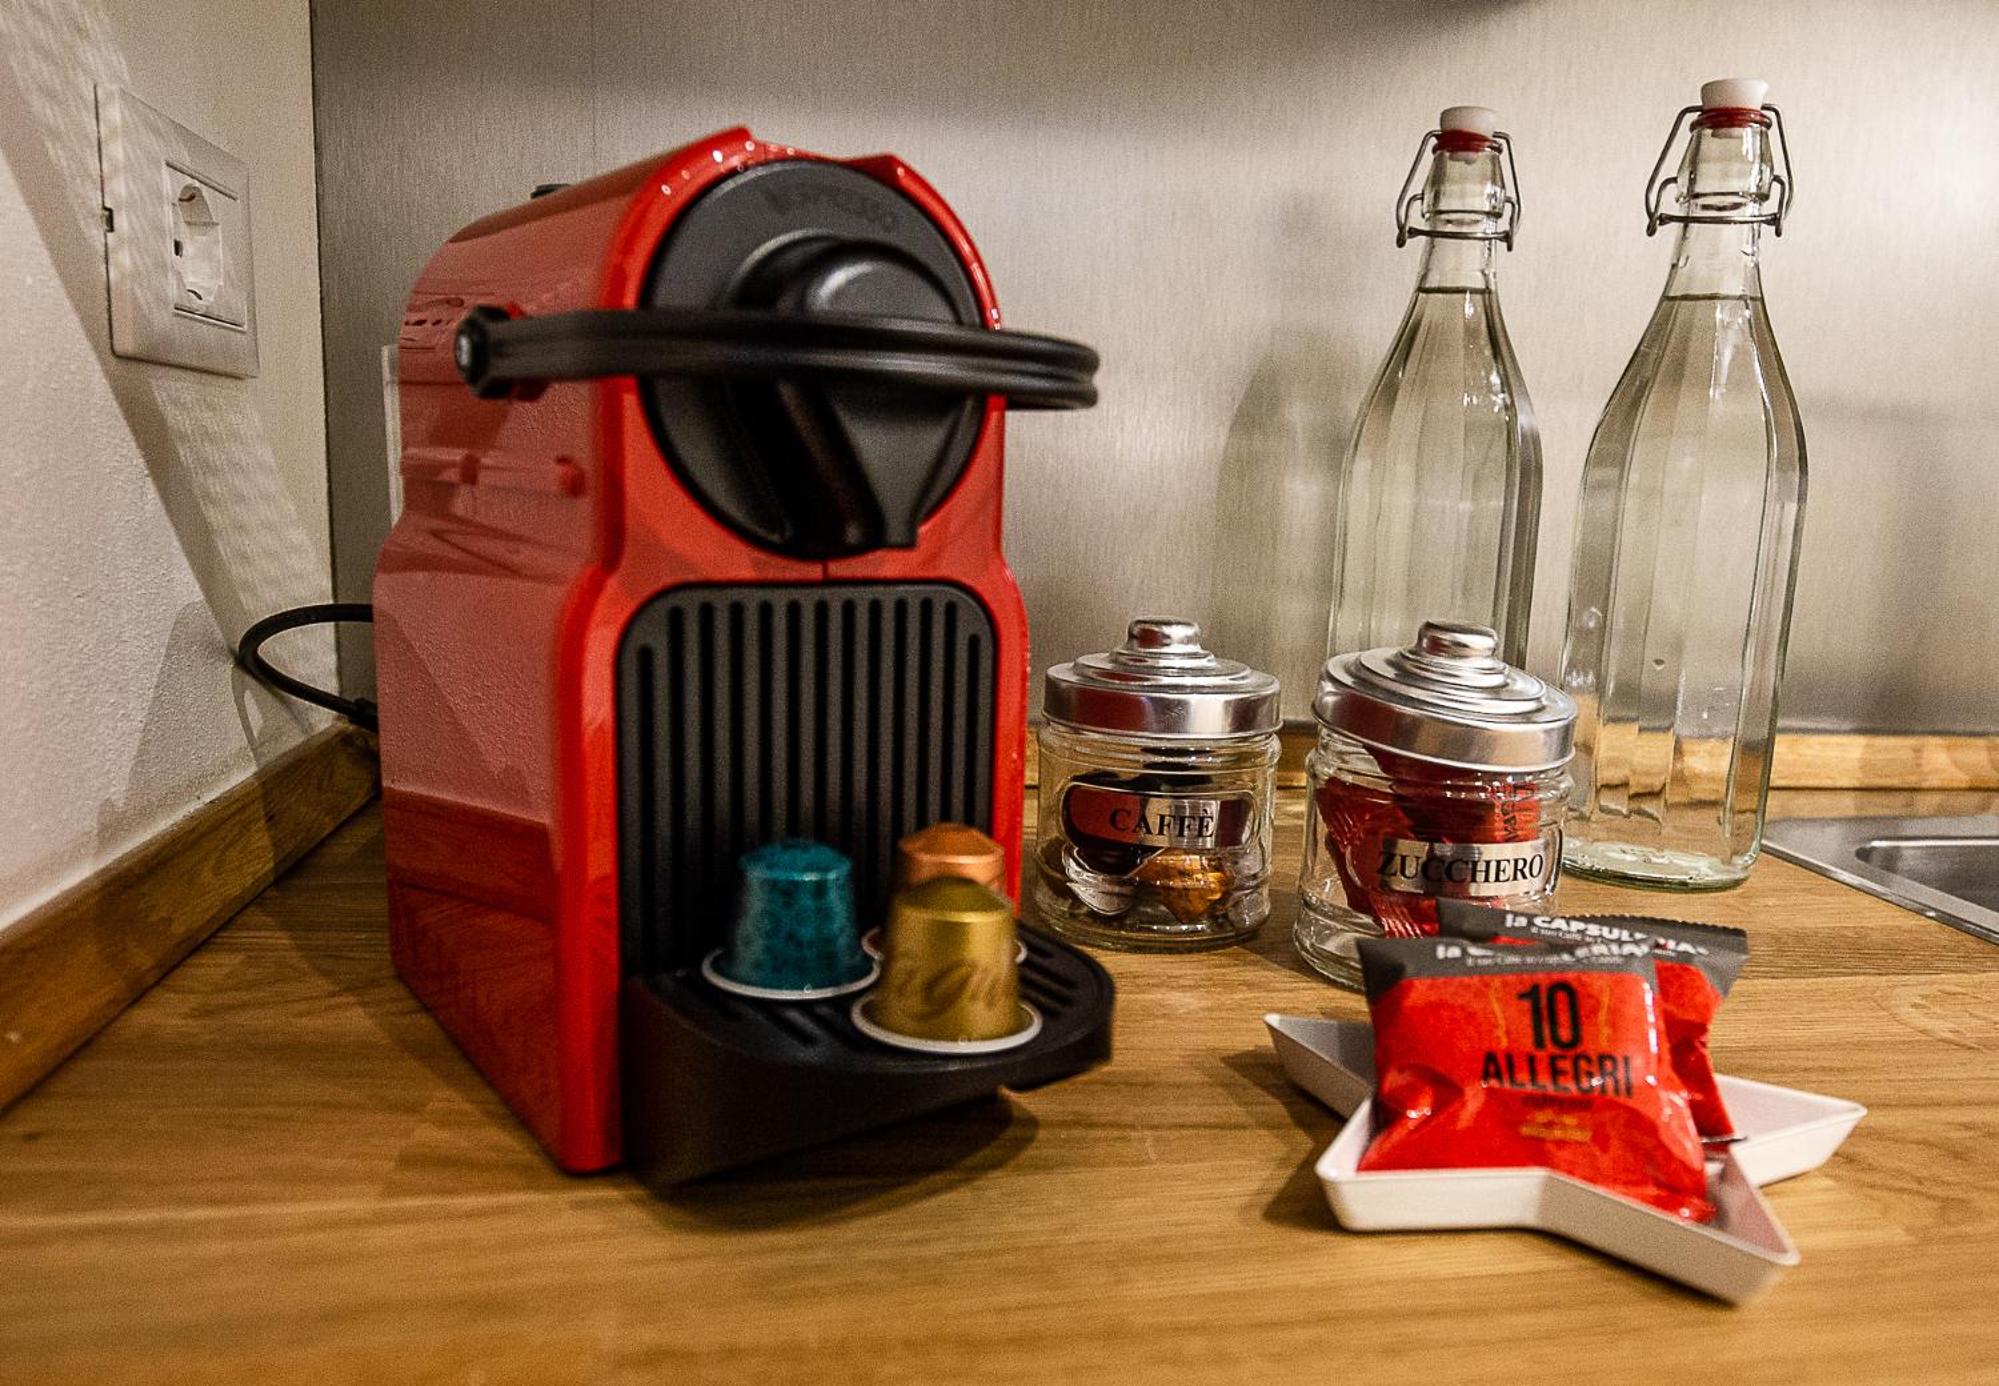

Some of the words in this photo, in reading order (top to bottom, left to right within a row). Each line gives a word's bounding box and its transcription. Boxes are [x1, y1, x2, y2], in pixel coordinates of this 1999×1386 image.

[1109, 808, 1214, 838] CAFFÈ
[1376, 852, 1544, 884] ZUCCHERO
[1518, 981, 1581, 1050] 10
[1481, 1052, 1632, 1099] ALLEGRI
